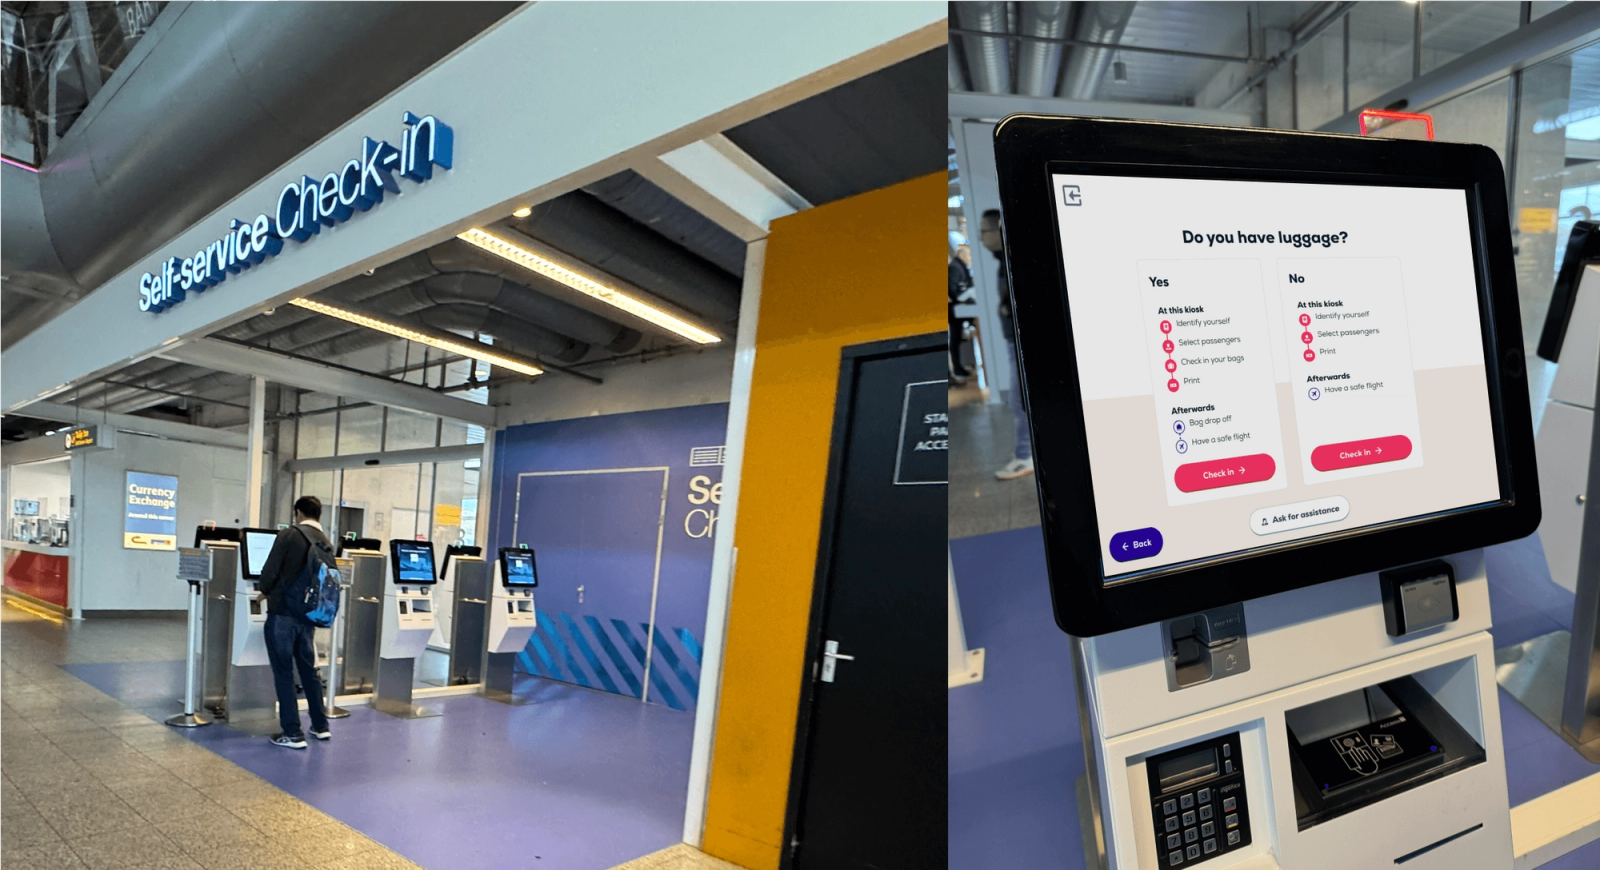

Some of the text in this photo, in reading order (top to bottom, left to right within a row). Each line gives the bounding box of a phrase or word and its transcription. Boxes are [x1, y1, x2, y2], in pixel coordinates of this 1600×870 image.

[138, 111, 439, 313] Self-service Check-in
[1183, 230, 1348, 247] Do you have luggage?
[1149, 277, 1169, 288] Yes
[1289, 274, 1304, 284] No
[1308, 300, 1322, 308] this
[1324, 299, 1343, 308] kiosk
[1169, 306, 1183, 315] this
[1185, 305, 1204, 314] kiosk
[1315, 310, 1369, 321] Identify yourself
[1176, 317, 1230, 328] Identify yourself
[1318, 328, 1379, 338] Select passengers
[1179, 336, 1241, 347] Select passengers
[1181, 357, 1201, 366] Check
[1211, 356, 1225, 365] your
[1227, 355, 1244, 364] bags
[1184, 377, 1200, 385] Print
[1306, 373, 1350, 383] Afterwards
[1350, 383, 1364, 391] safe
[1367, 381, 1383, 391] flight
[1171, 404, 1215, 414] Afterwards
[1190, 414, 1231, 428] Bag drop off
[1191, 438, 1211, 446] Have
[1217, 434, 1231, 443] safe
[1234, 432, 1250, 442] flight
[1340, 448, 1371, 460] Check in
[1203, 467, 1235, 480] Check in
[129, 483, 175, 499] Currency
[129, 495, 175, 509] Exchange
[1273, 505, 1340, 524] Ask for assistance
[1133, 538, 1151, 549] Back
